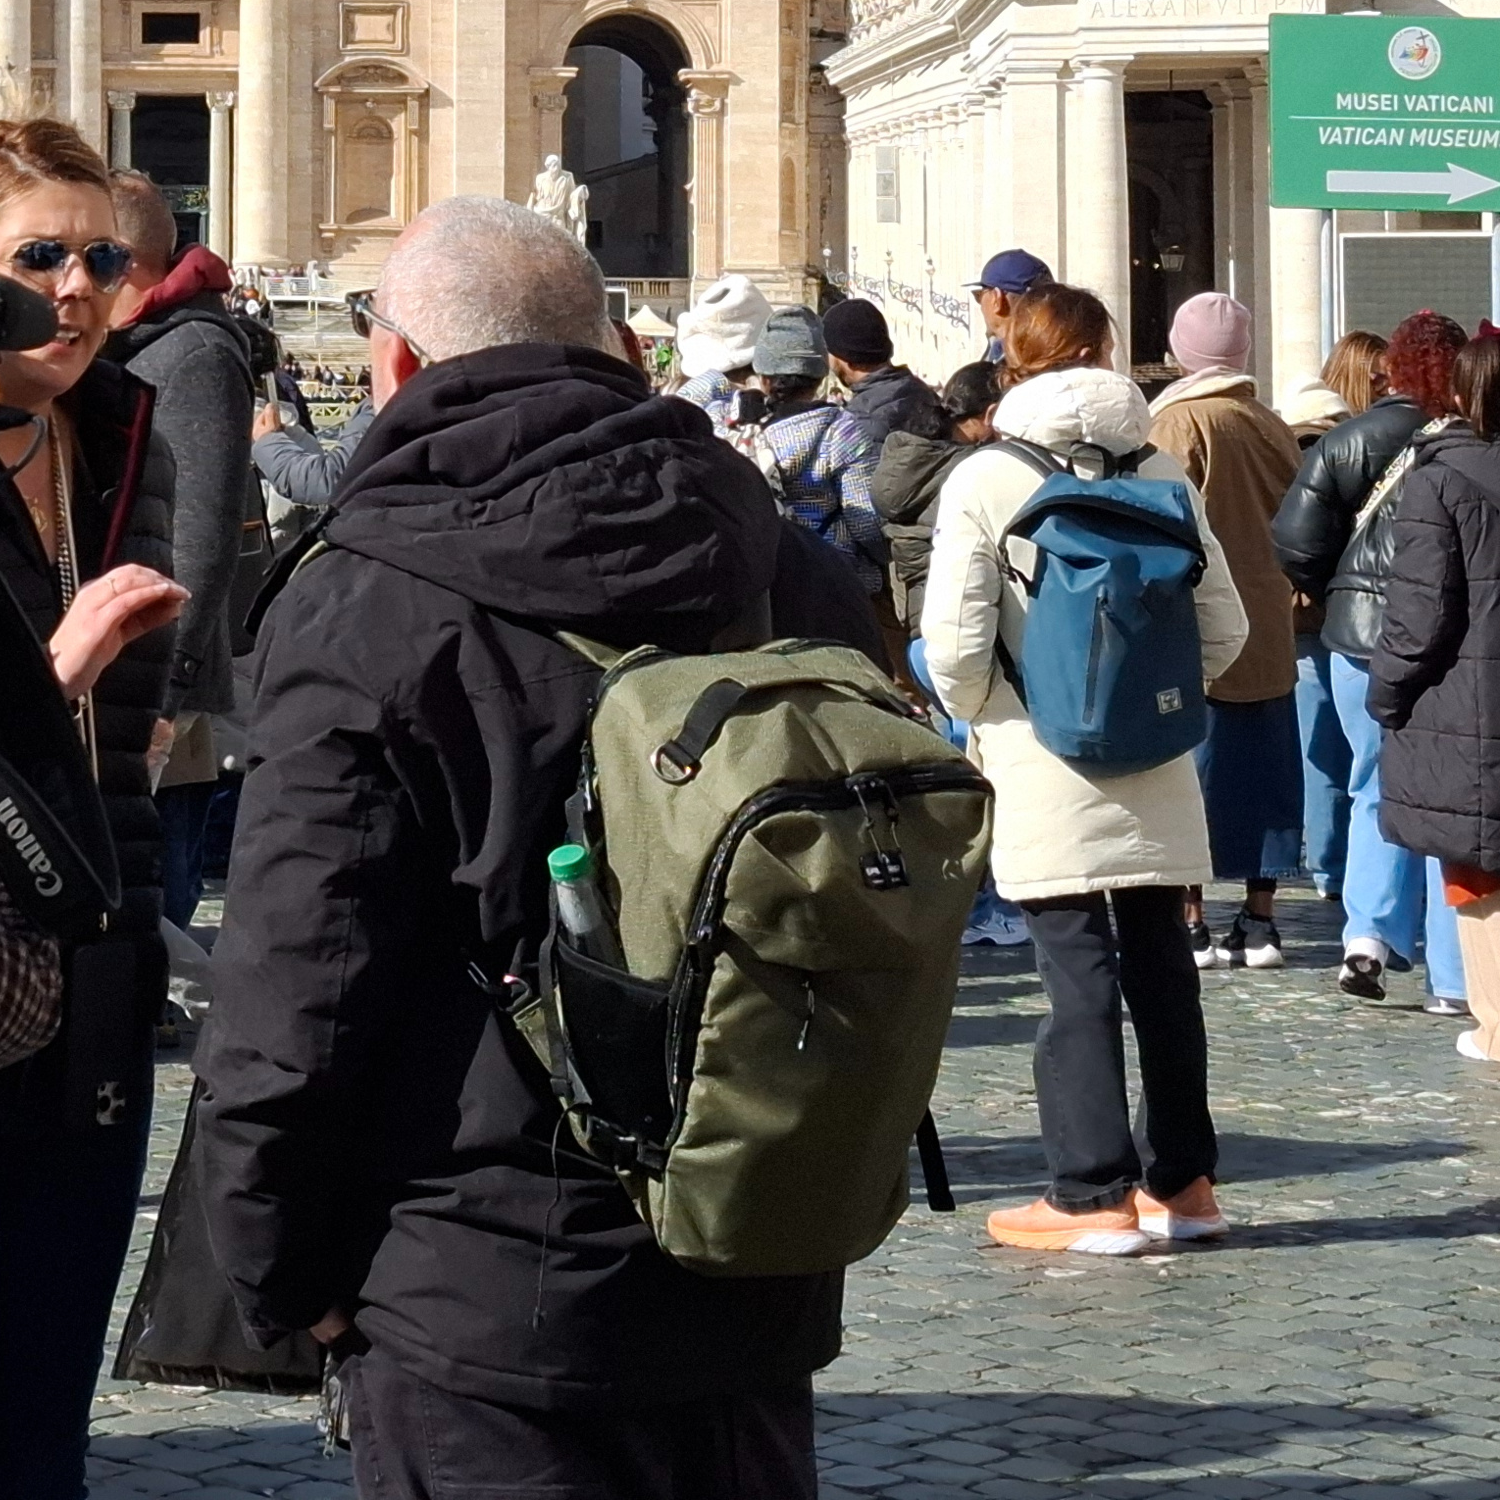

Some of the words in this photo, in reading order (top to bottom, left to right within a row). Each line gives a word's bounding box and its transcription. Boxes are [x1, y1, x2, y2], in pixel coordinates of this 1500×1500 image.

[1336, 92, 1398, 112] MUSEI
[1404, 94, 1494, 114] VATICANI
[1319, 126, 1405, 146] VATICAN
[1409, 128, 1500, 149] MUSEUM
